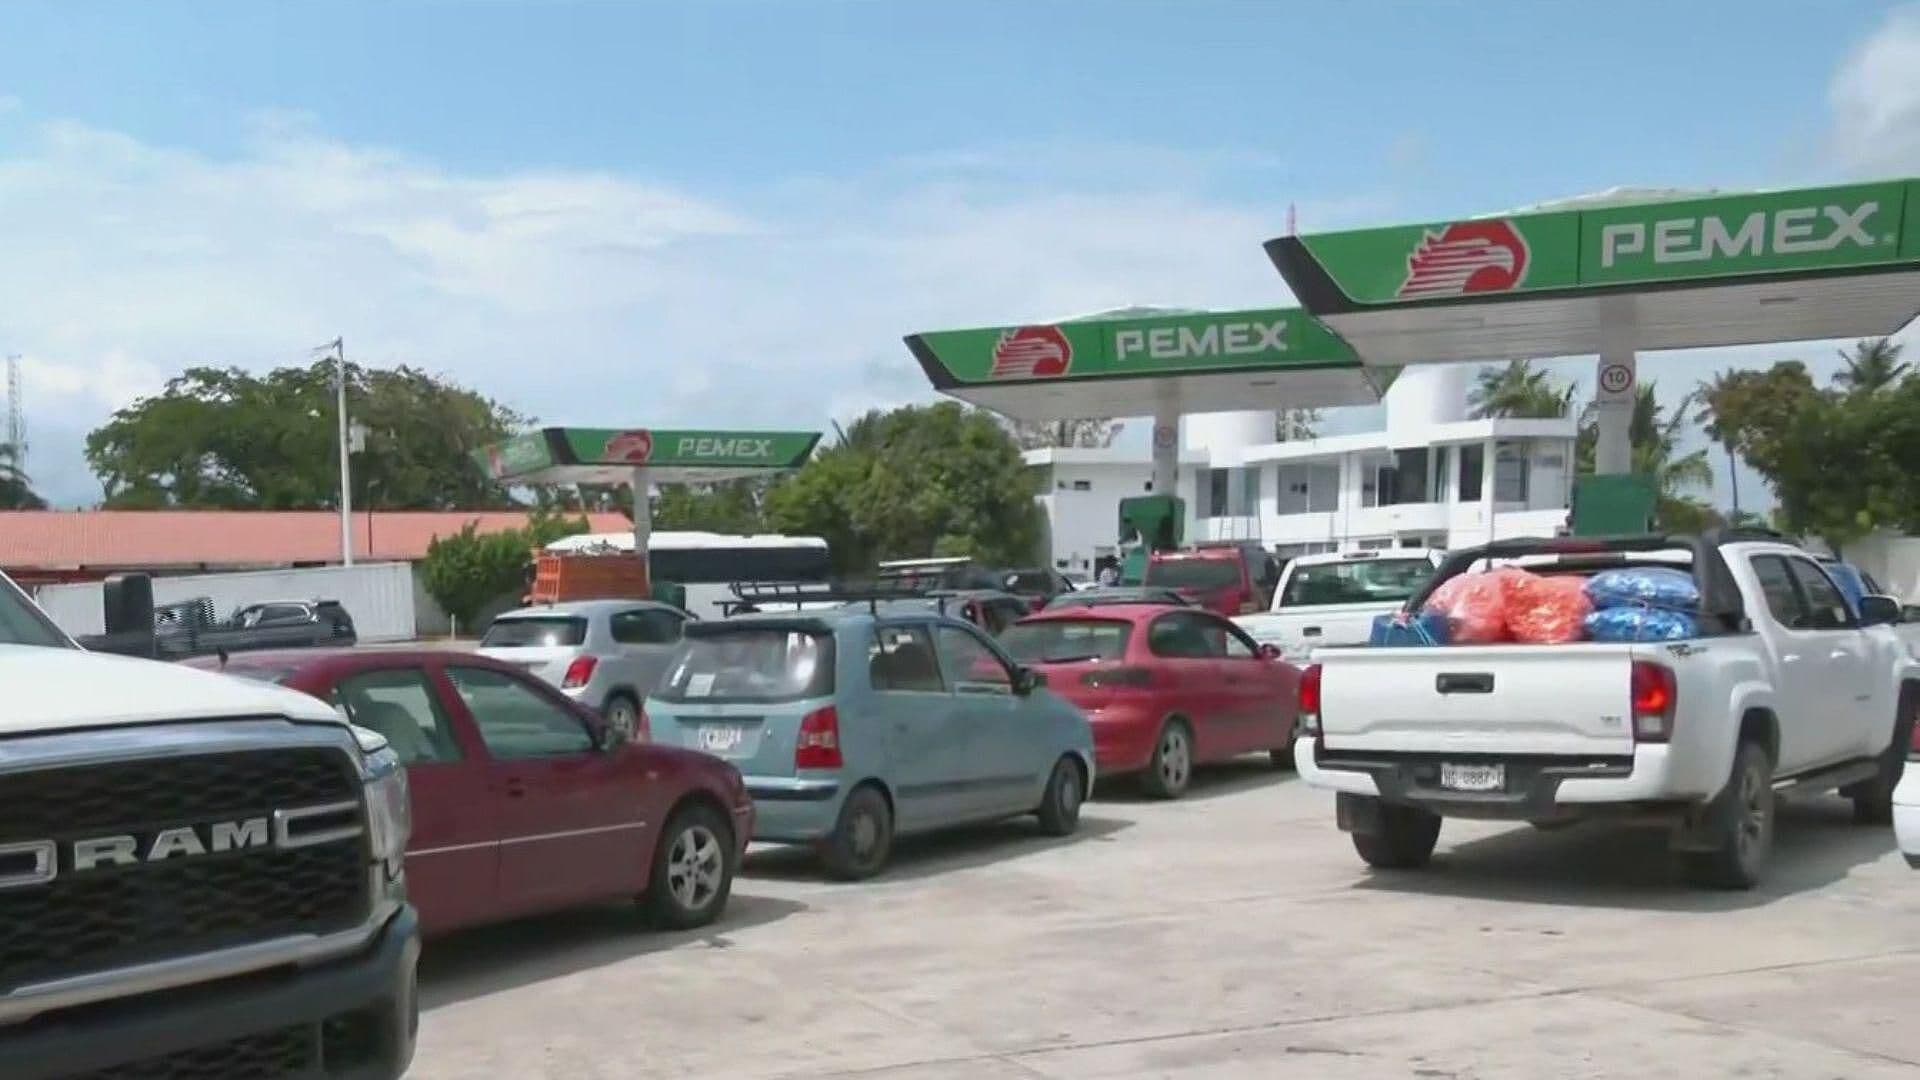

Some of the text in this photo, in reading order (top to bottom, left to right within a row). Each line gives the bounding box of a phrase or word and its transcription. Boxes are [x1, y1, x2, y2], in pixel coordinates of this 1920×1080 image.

[1602, 201, 1878, 267] PEMEX
[1116, 320, 1287, 361] PEMEX
[1608, 371, 1625, 384] 10
[677, 438, 769, 457] PEMEX
[75, 818, 268, 871] RAM
